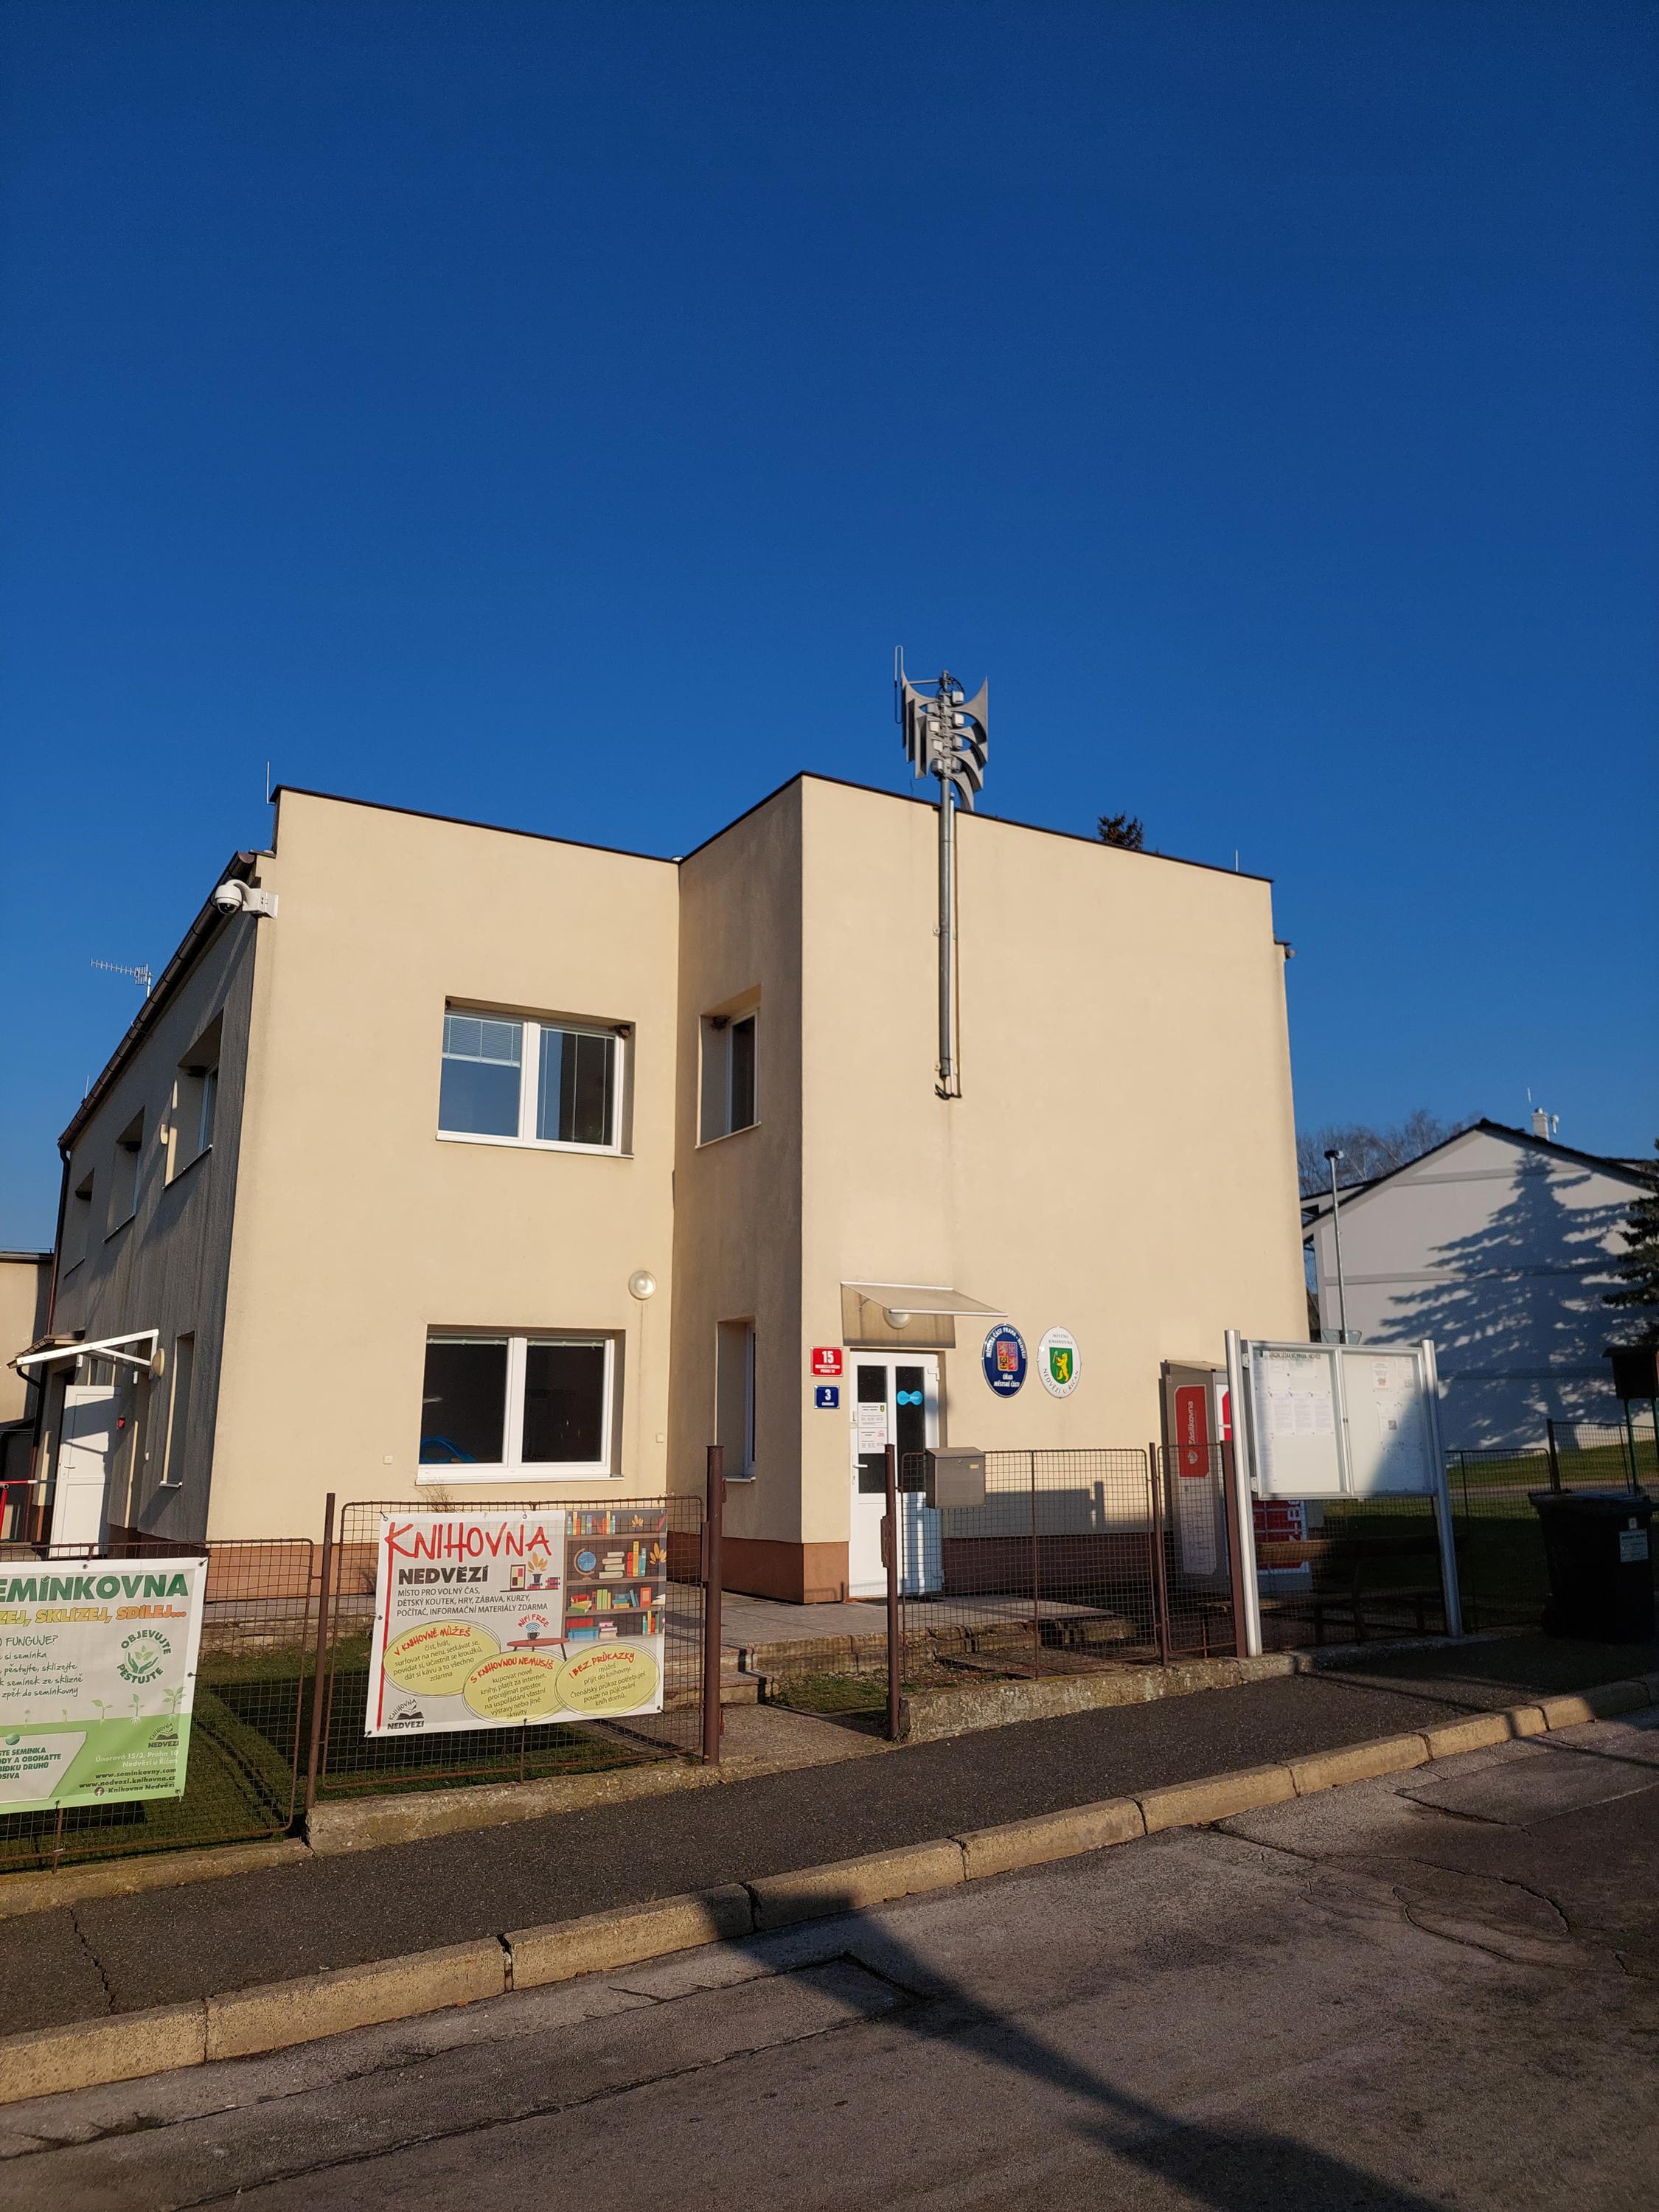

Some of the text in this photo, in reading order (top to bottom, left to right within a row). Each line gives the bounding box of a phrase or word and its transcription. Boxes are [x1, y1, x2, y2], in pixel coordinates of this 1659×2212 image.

[822, 1351, 834, 1363] 15
[825, 1388, 831, 1400] 3
[384, 1522, 552, 1562] KNIHOVNA
[399, 1565, 489, 1585] NEDVĚZÍ
[398, 1588, 420, 1596] MÍSTO
[437, 1587, 463, 1595] VOLNÝ
[465, 1586, 480, 1594] ČAS,
[397, 1597, 424, 1607] DĚTSKÝ
[425, 1598, 456, 1606] KOUTEK,
[475, 1595, 505, 1604] ZÁBAVA,
[507, 1594, 530, 1602] KURZY,
[35, 1607, 113, 1624] SKLÍZEJ,
[397, 1603, 548, 1616] POČÍTAČ, INFORMAČNÍ MATERIÁLY ZDARMA
[532, 1614, 549, 1627] FREE
[6, 1635, 59, 1646] FUNGUJE?
[121, 1630, 171, 1655] OBJEVUJTE
[394, 1625, 472, 1656] V KNIHOVNĚ MŮŽEŠ
[14, 1649, 46, 1660] semínka
[394, 1655, 421, 1667] surfovat
[446, 1643, 470, 1653] setkávat
[4, 1661, 77, 1676] pěstujte, sklízejte
[404, 1672, 415, 1681] dát
[422, 1667, 437, 1676] kávu
[451, 1657, 474, 1668] všechno
[477, 1658, 517, 1677] KNIHOVNOU
[572, 1660, 593, 1676] BEZ
[591, 1652, 635, 1665] PRŮKAZKY
[7, 1676, 40, 1686] semínek
[430, 1672, 453, 1682] zdarma
[492, 1672, 517, 1683] kupovat
[520, 1682, 542, 1693] prostor
[598, 1680, 617, 1691] průkaz
[1, 1687, 21, 1700] zpět
[34, 1685, 78, 1697] semínkovny
[583, 1693, 600, 1703] pouze
[514, 1700, 529, 1709] nebo
[595, 1697, 608, 1706] knih
[147, 1750, 168, 1759] Praha
[108, 1785, 143, 1793] Knihovna
